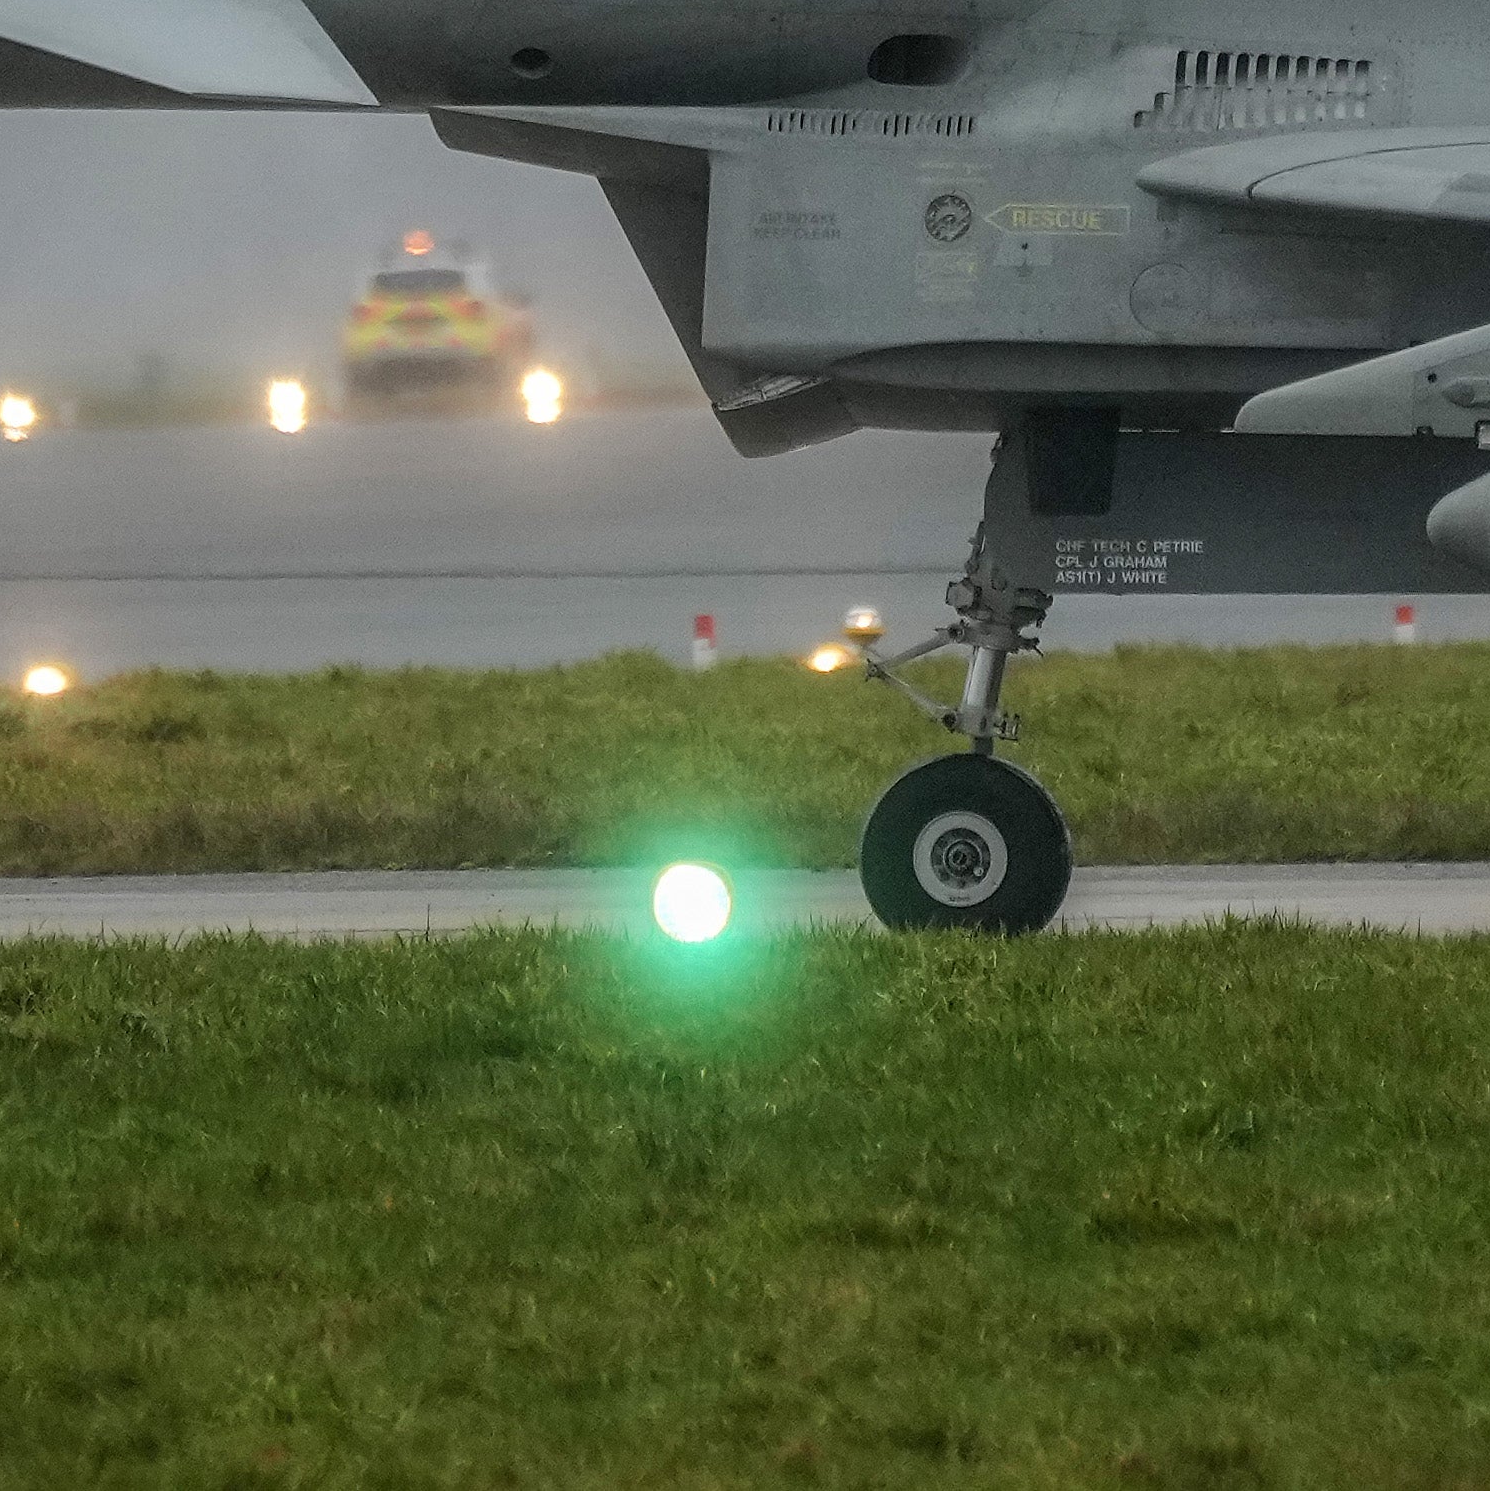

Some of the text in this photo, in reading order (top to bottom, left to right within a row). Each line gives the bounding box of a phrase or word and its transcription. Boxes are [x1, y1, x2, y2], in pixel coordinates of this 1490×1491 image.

[1011, 209, 1101, 230] RESCUE
[1093, 540, 1131, 553] TECH
[1153, 541, 1204, 553] PETRIE
[1055, 555, 1168, 568] CPL J GRAHAM
[1107, 571, 1116, 584] J
[1121, 571, 1168, 584] WHITE
